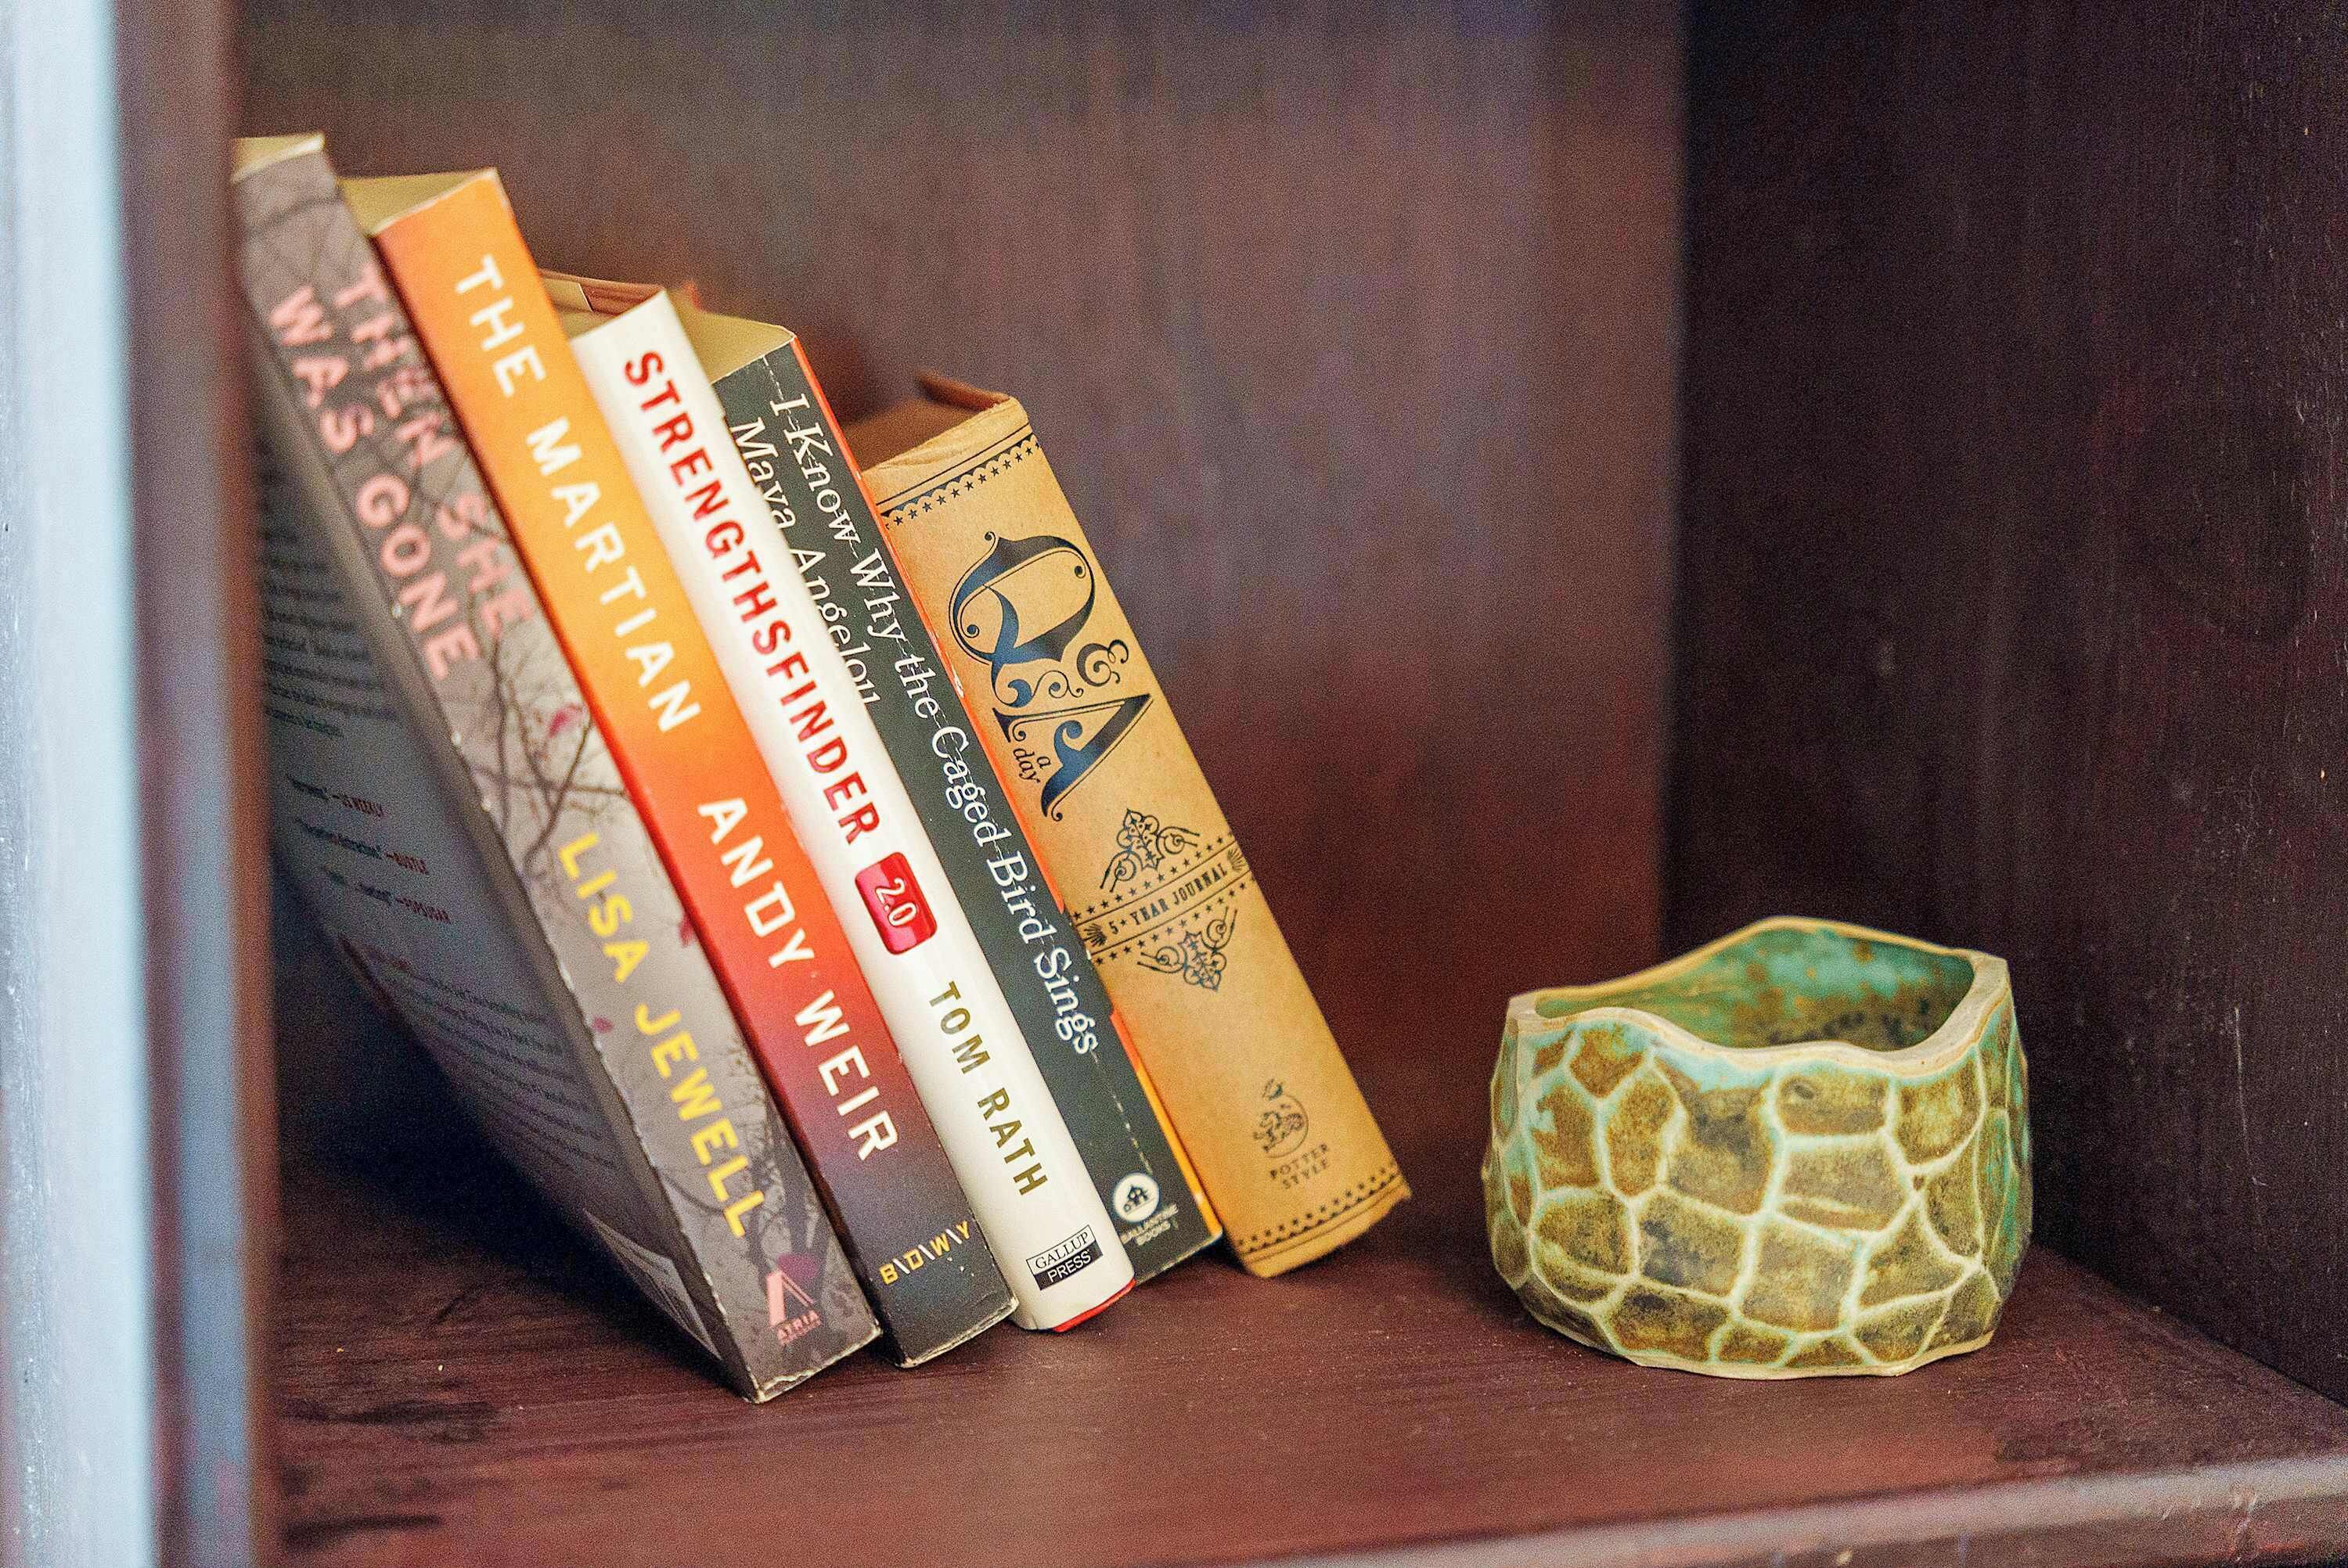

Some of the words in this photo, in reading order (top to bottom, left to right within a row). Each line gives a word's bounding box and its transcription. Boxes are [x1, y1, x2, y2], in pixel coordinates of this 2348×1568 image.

[335, 264, 462, 467] THEN
[434, 492, 535, 638] SHE
[769, 393, 811, 416] I
[269, 286, 377, 455] WAS
[356, 473, 481, 681] GONE
[455, 254, 548, 400] THE
[525, 414, 703, 734] MARTIAN
[783, 422, 862, 545] Know
[625, 349, 882, 847] STRENGTHSFINDER
[850, 548, 909, 642] Why
[895, 653, 939, 719] the
[930, 725, 1013, 848] Caged
[1013, 748, 1041, 783] day
[875, 877, 917, 926] 2.0
[986, 851, 1057, 944] Bird
[1129, 897, 1170, 926] YEAR
[1172, 862, 1228, 905] JOURNAL
[698, 795, 815, 969] ANDY
[795, 990, 899, 1162] WEIR
[1033, 947, 1100, 1056] Sings
[558, 832, 650, 984] LISA
[635, 1003, 769, 1238] JEWELL
[928, 980, 992, 1076] TOM
[978, 1086, 1050, 1198] RATH
[1269, 1142, 1328, 1180] POTTER
[1034, 1231, 1089, 1269] GALLUP
[1046, 1250, 1092, 1283] PRESS
